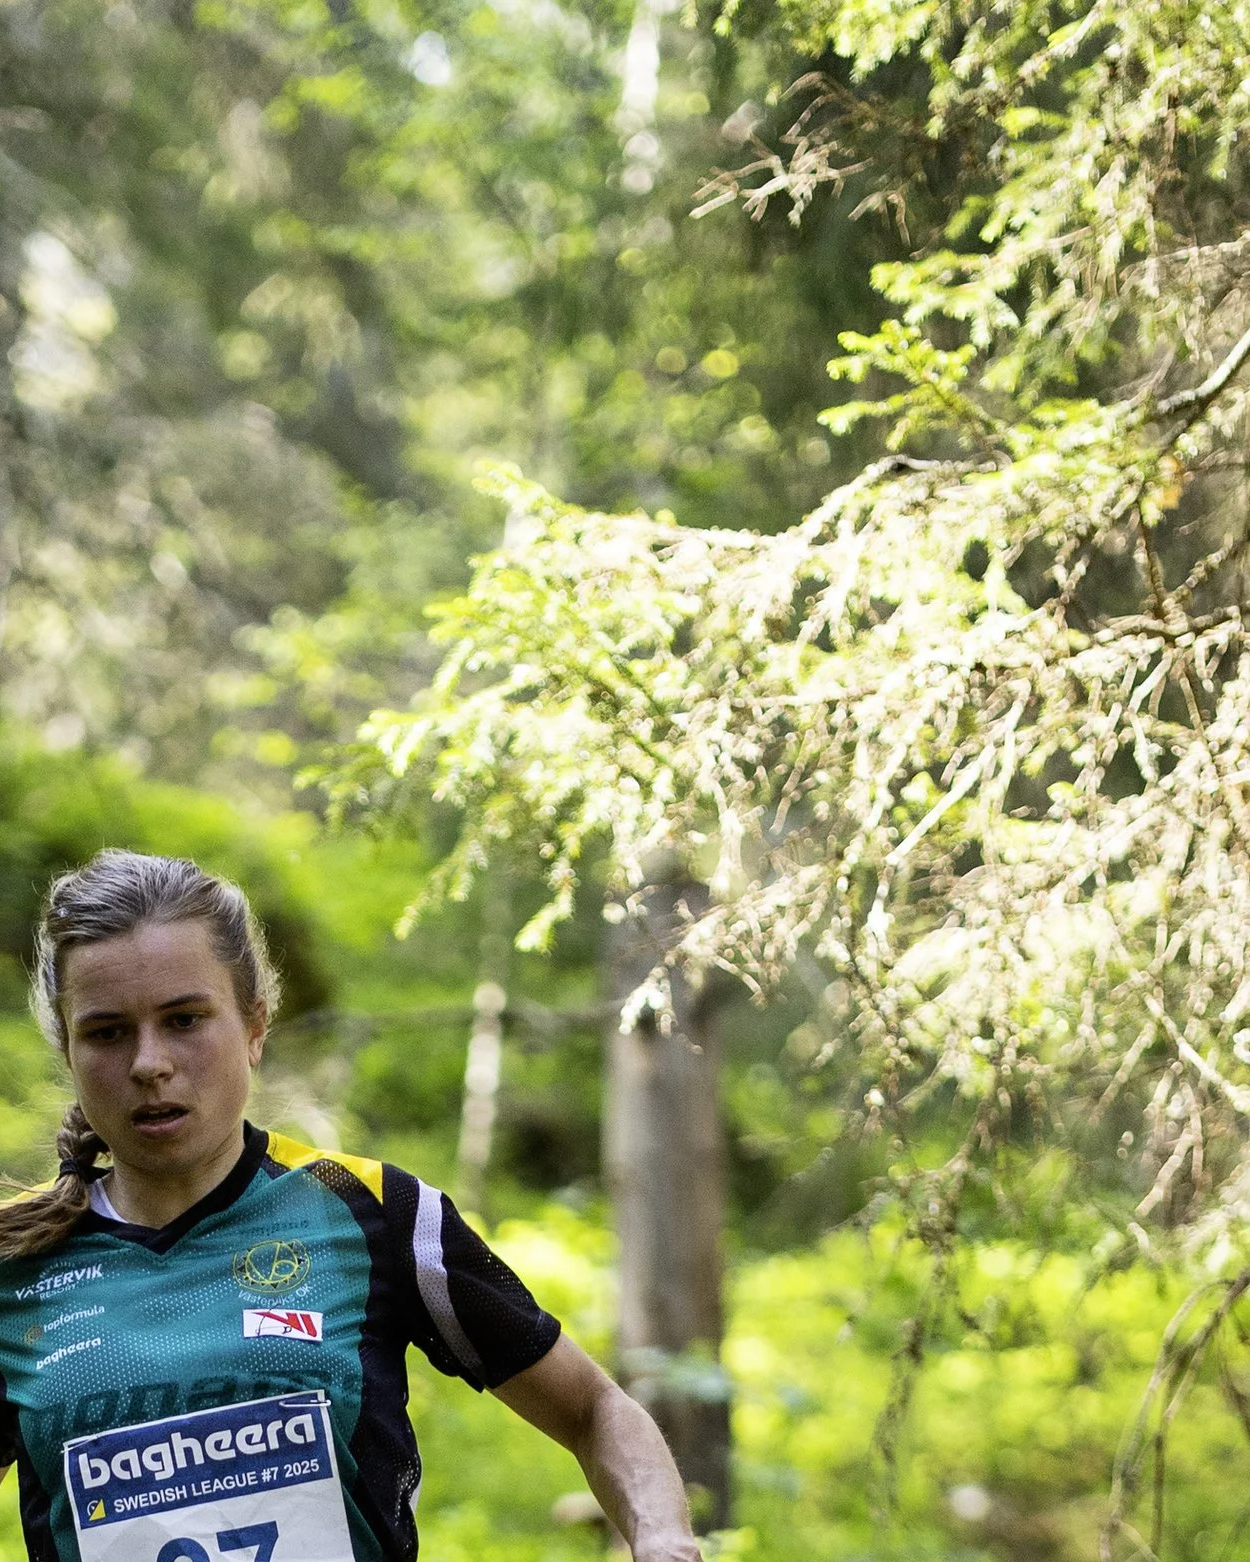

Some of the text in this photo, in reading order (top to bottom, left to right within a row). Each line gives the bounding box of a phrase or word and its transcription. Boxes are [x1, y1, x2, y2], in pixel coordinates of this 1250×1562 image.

[15, 1263, 102, 1300] VÄSTERVIK
[296, 1283, 314, 1298] OK
[43, 1305, 105, 1333] topformula
[36, 1336, 102, 1370] bagheera
[78, 1413, 317, 1490] bagheera
[114, 1458, 320, 1513] SWEDISH LEAGUE #7 2025
